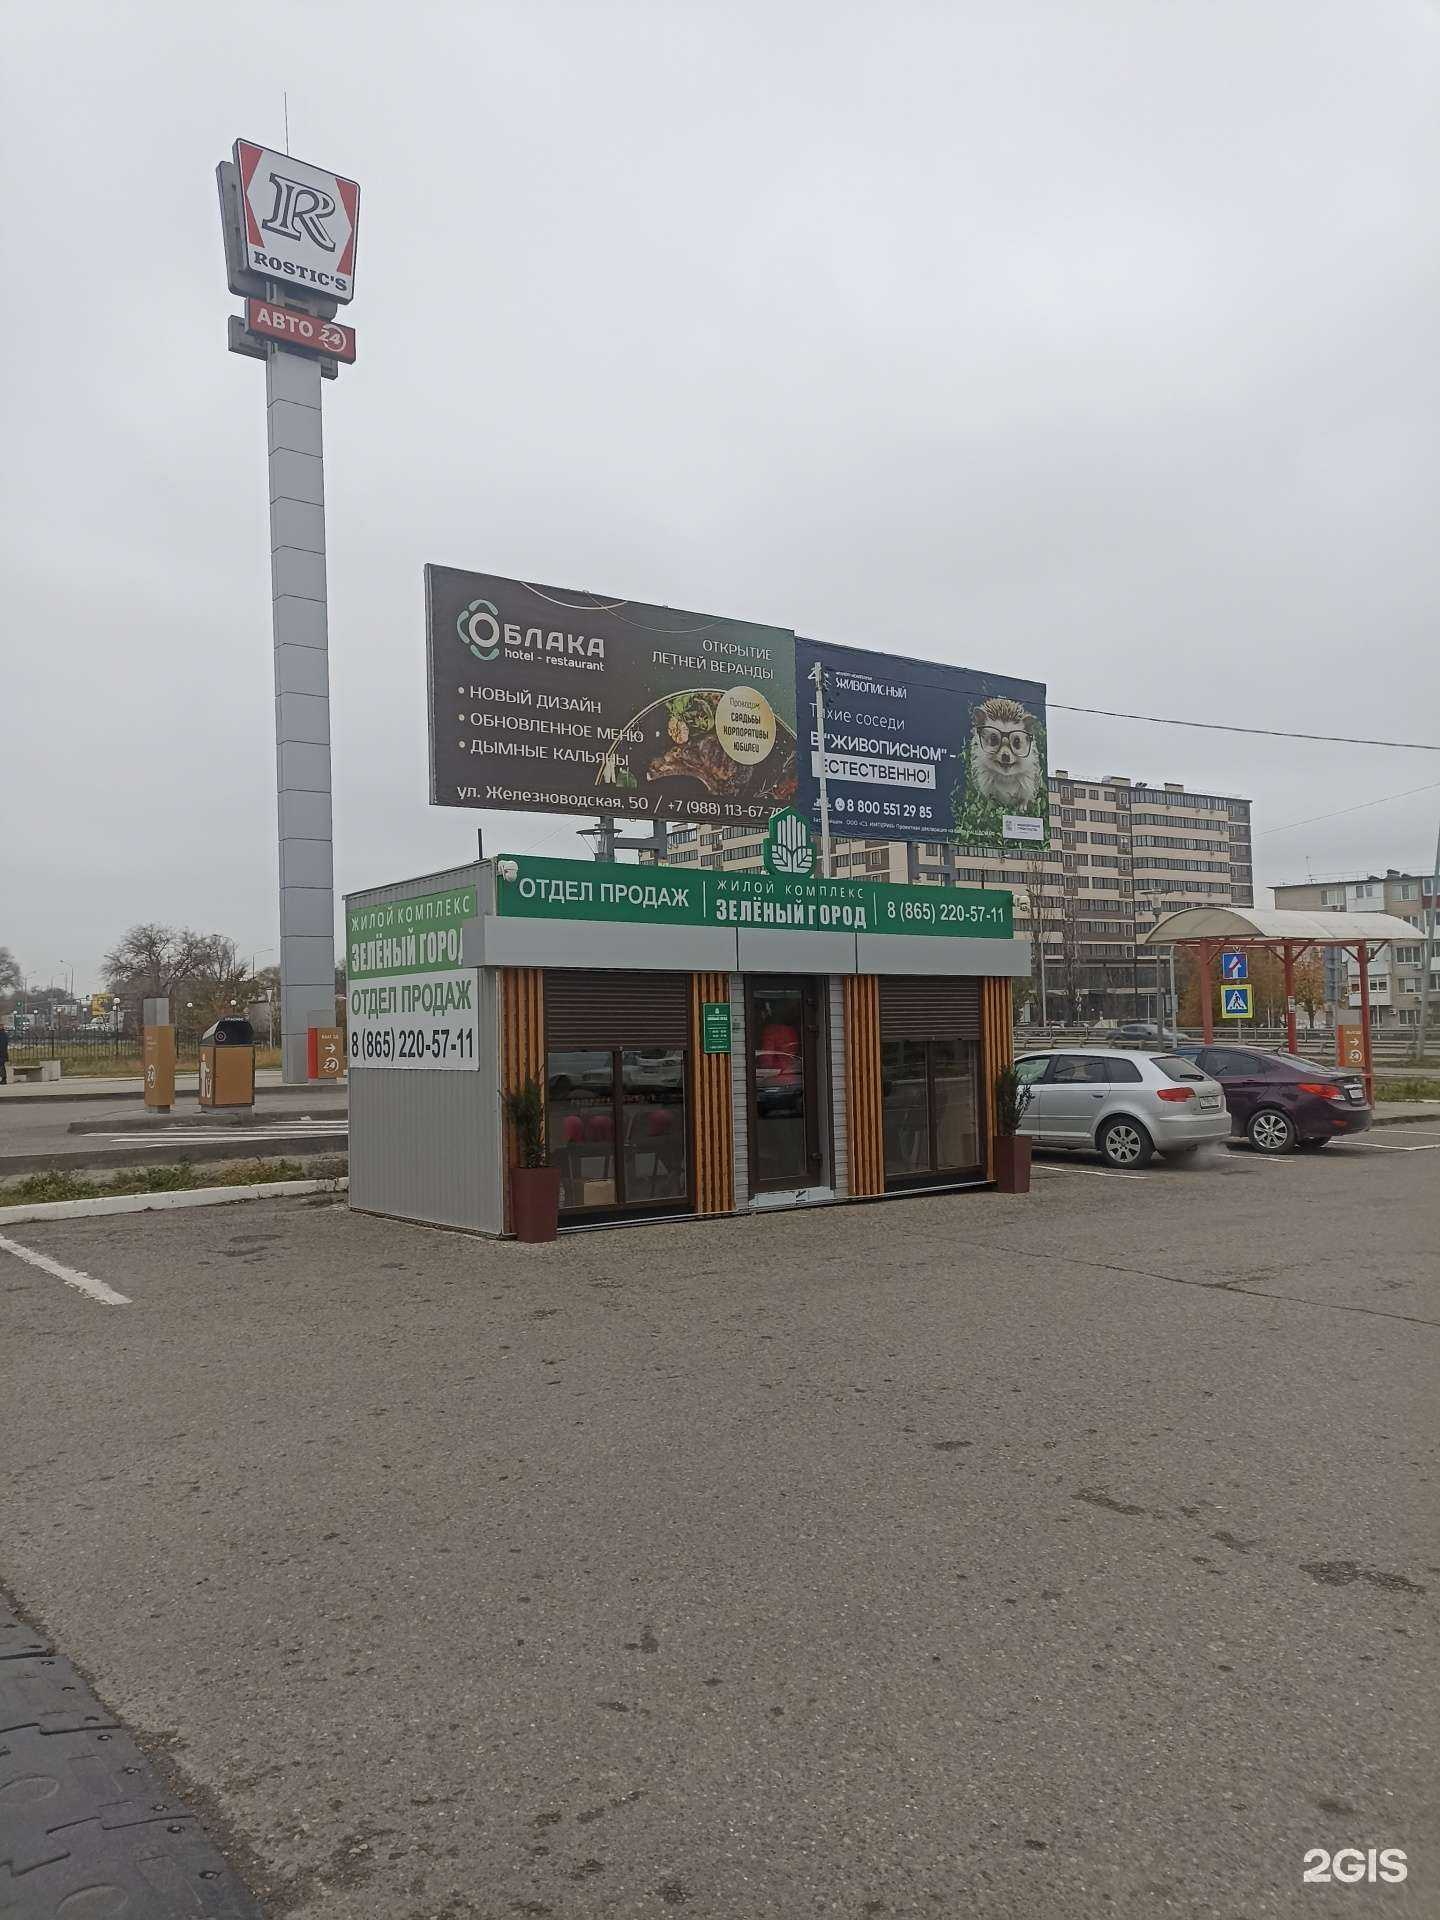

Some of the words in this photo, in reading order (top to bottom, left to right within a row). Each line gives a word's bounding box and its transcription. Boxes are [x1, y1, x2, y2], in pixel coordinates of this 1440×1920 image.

[254, 251, 347, 292] ROSTIC'S
[257, 308, 314, 338] АВТО
[319, 328, 341, 348] 24
[505, 648, 533, 662] hotel
[546, 655, 604, 672] restaurant
[703, 639, 772, 661] ОТКРЫТИЕ
[652, 651, 707, 671] ЛЕТНЕЙ
[711, 661, 774, 681] ВЕРАНДЫ
[470, 686, 531, 705] НОВЫЙ
[537, 691, 602, 714] ДИЗАЙН
[836, 677, 907, 699] ЖИВОПИСНЫЙ
[470, 712, 592, 738] ОБНОВЛЕННОЕ
[598, 727, 644, 743] МЕНЮ
[731, 712, 761, 725] СВАДЬБЫ
[809, 702, 852, 723] Тхие
[856, 713, 905, 731] соседи
[470, 740, 548, 760] ДЫМНЫЕ
[554, 748, 629, 766] КАЛЬЯНЫ
[457, 786, 480, 800] ул.
[629, 796, 648, 810] 50
[669, 801, 683, 813] +7
[687, 801, 721, 816] (988)
[847, 799, 854, 812] 8
[857, 799, 880, 815] 800
[883, 802, 901, 816] 551
[903, 804, 916, 817] 29
[920, 806, 933, 819] 85
[519, 877, 593, 904] ОТДЕЛ
[600, 883, 689, 909] ПРОДАЖ
[717, 879, 774, 894] ЖИЛОЙ
[785, 885, 864, 899] КОМПЛЕКС
[351, 905, 394, 931] ЖИЛОЙ
[398, 895, 471, 924] КОМПЛЕКС
[716, 897, 804, 924] ЗЕЛЁНЫЙ
[808, 904, 867, 929] ГОРОД
[887, 901, 896, 918] 8
[900, 901, 936, 924] (865)
[940, 904, 1004, 923] 220-57-11
[352, 926, 416, 972] ЗЕЛЁНЫЙ
[352, 986, 397, 1020] ОТДЕЛ
[401, 979, 472, 1016] ПРОДАЖ
[352, 1035, 360, 1058] 8
[362, 1028, 395, 1061] (865)
[399, 1028, 473, 1059] 220-57-11
